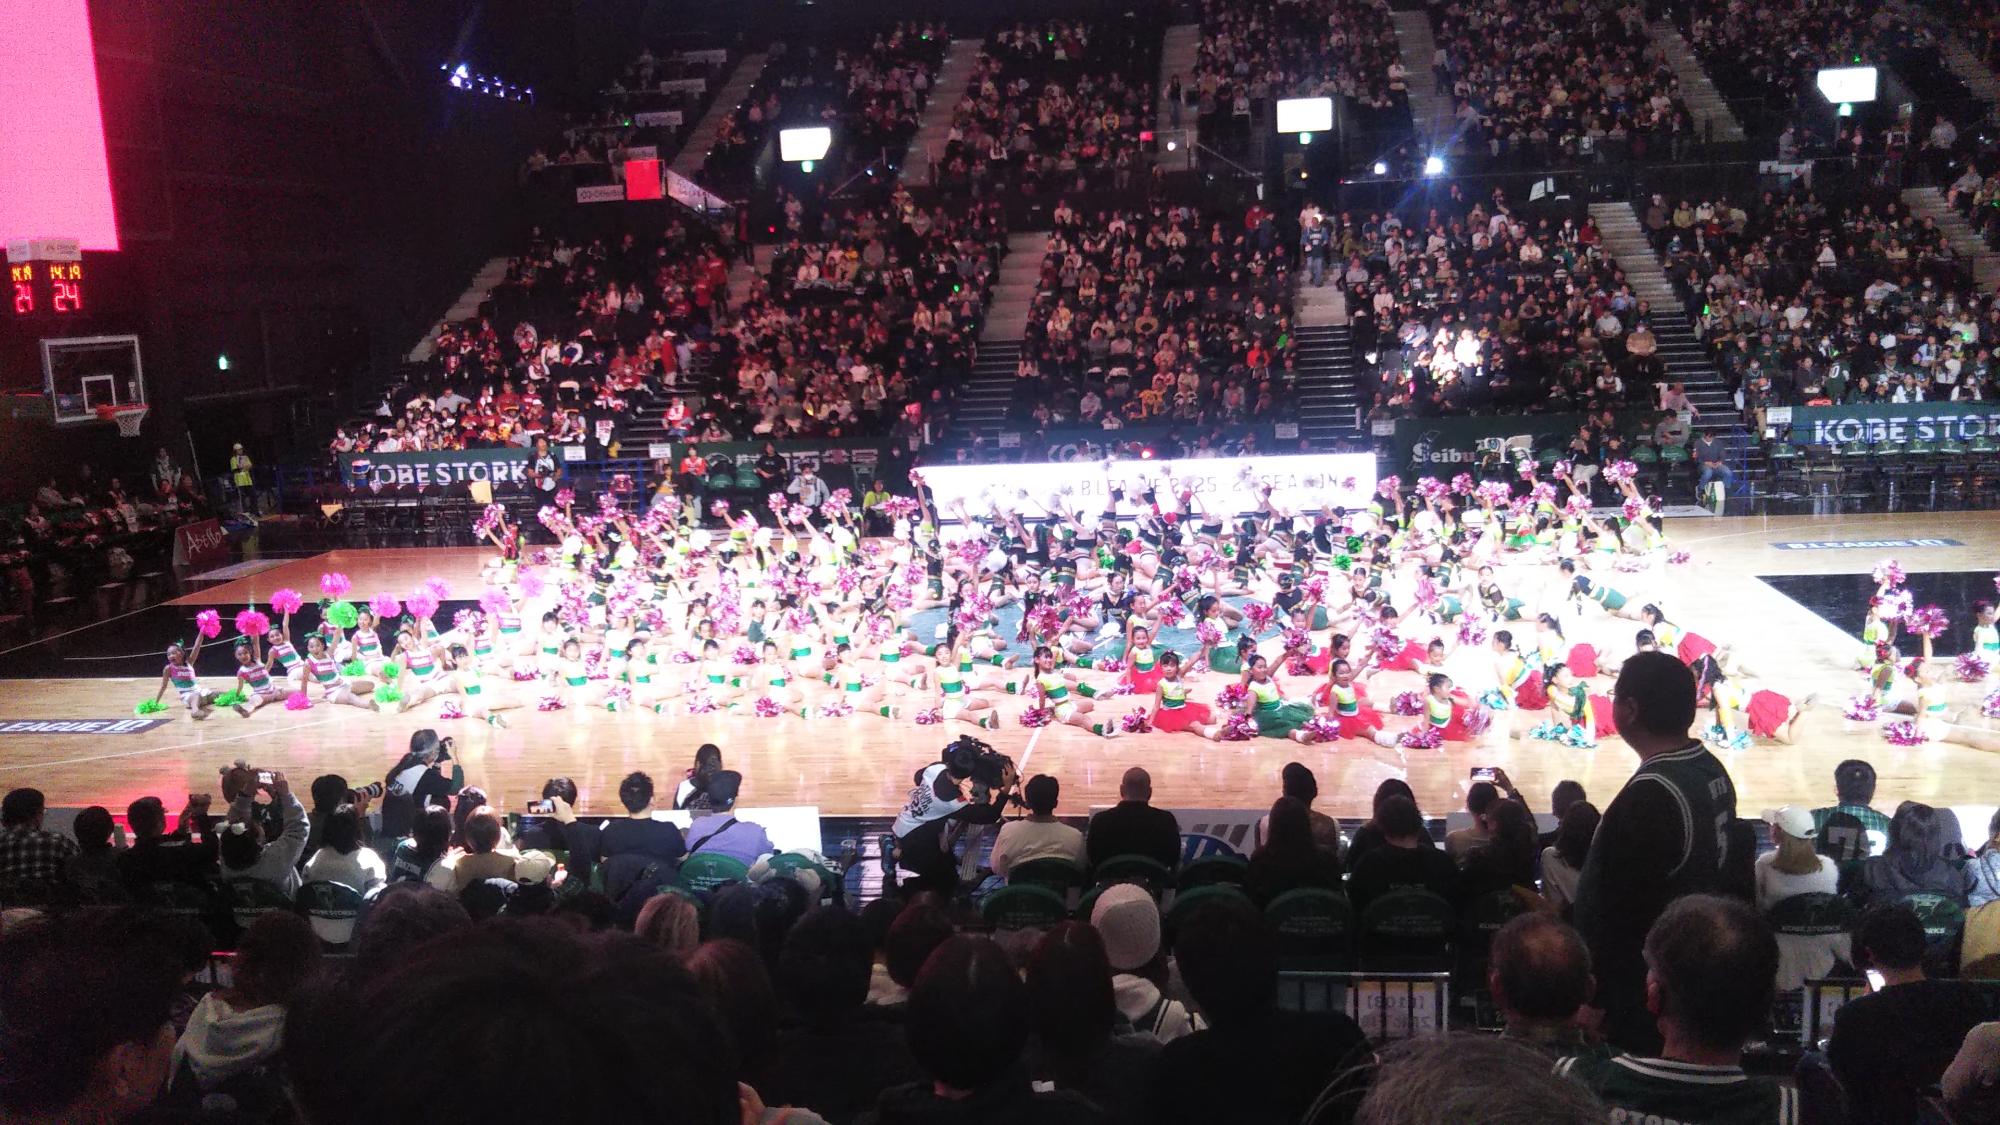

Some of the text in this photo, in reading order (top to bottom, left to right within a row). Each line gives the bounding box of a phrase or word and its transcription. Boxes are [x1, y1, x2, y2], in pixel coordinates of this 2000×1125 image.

[50, 264, 82, 280] 14:19
[54, 283, 81, 311] 24
[1814, 418, 1908, 444] KOBE
[370, 463, 431, 486] OBE
[0, 722, 112, 732] EAGUE
